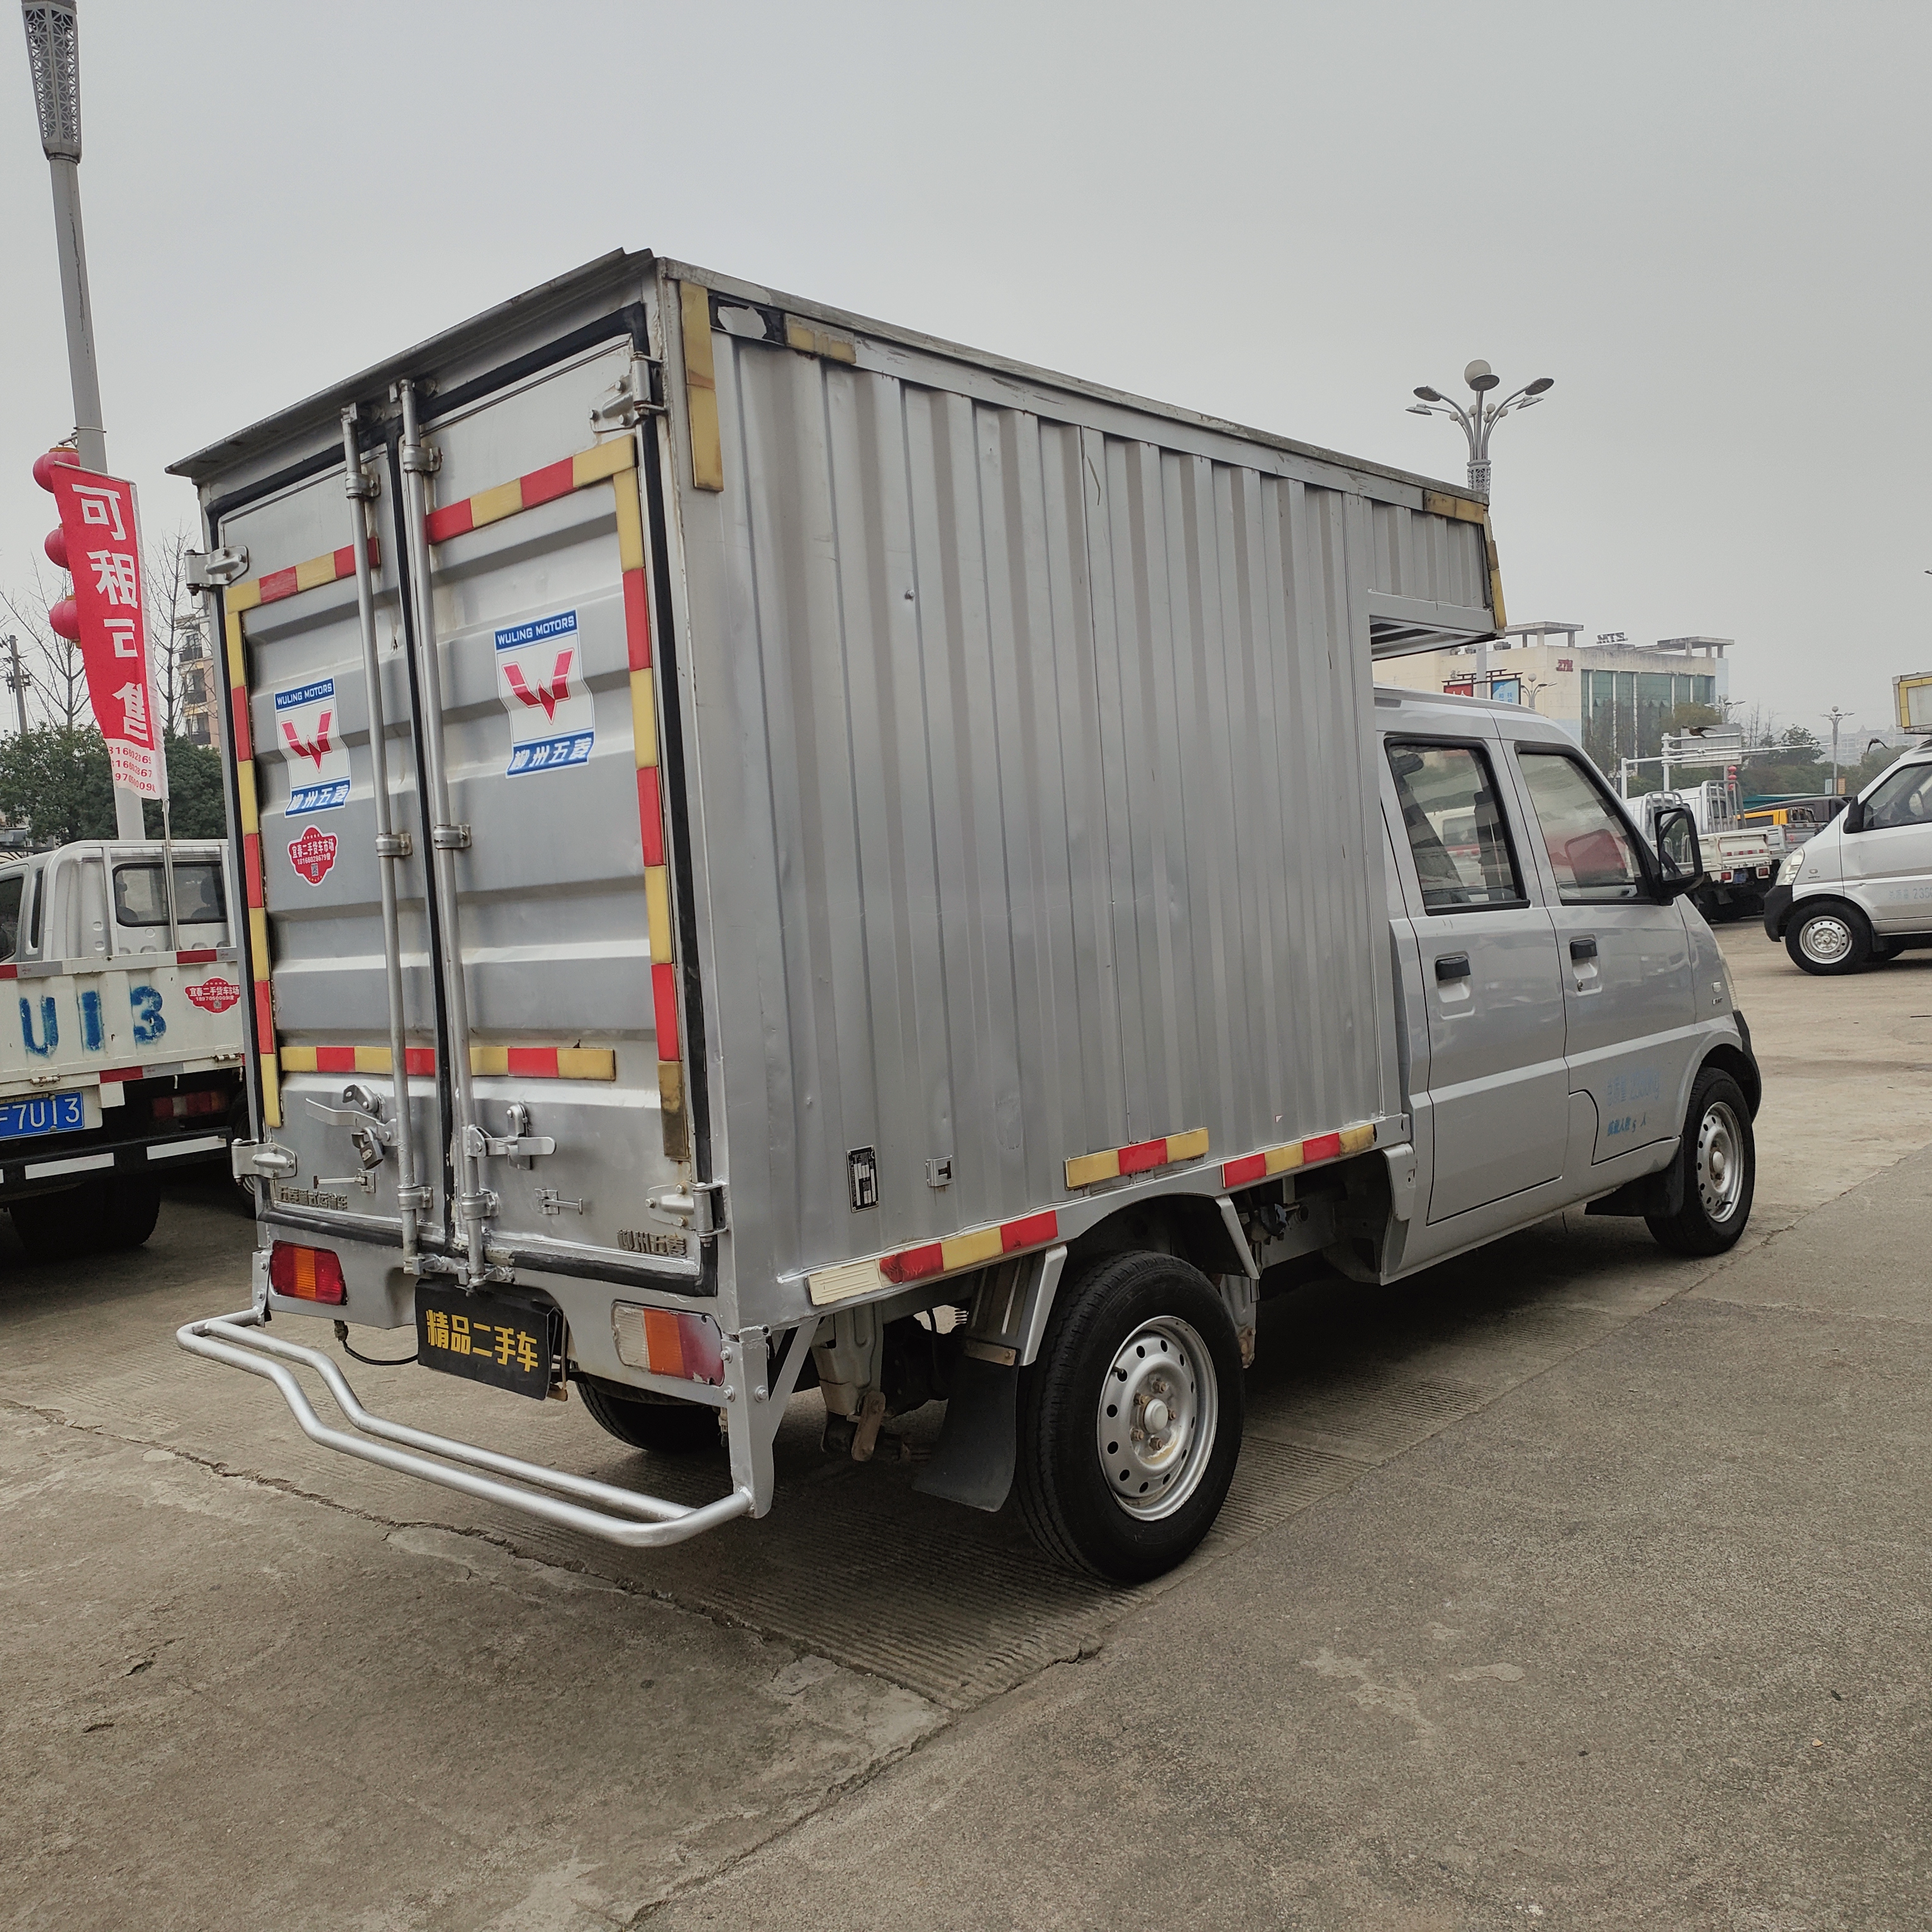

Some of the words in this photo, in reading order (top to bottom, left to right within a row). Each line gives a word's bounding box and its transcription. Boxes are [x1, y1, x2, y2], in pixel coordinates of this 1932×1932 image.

[497, 627, 533, 645] WULING
[536, 615, 575, 636] MOTORS
[277, 691, 303, 706] WULING
[304, 682, 333, 699] MOTORS
[509, 737, 592, 771] 柳州五菱
[286, 784, 349, 812] 柳州五菱
[292, 838, 335, 858] 宜春二手货车市场
[189, 986, 240, 997] 宜春二手货车市场
[426, 1309, 539, 1373] 精品二手车
